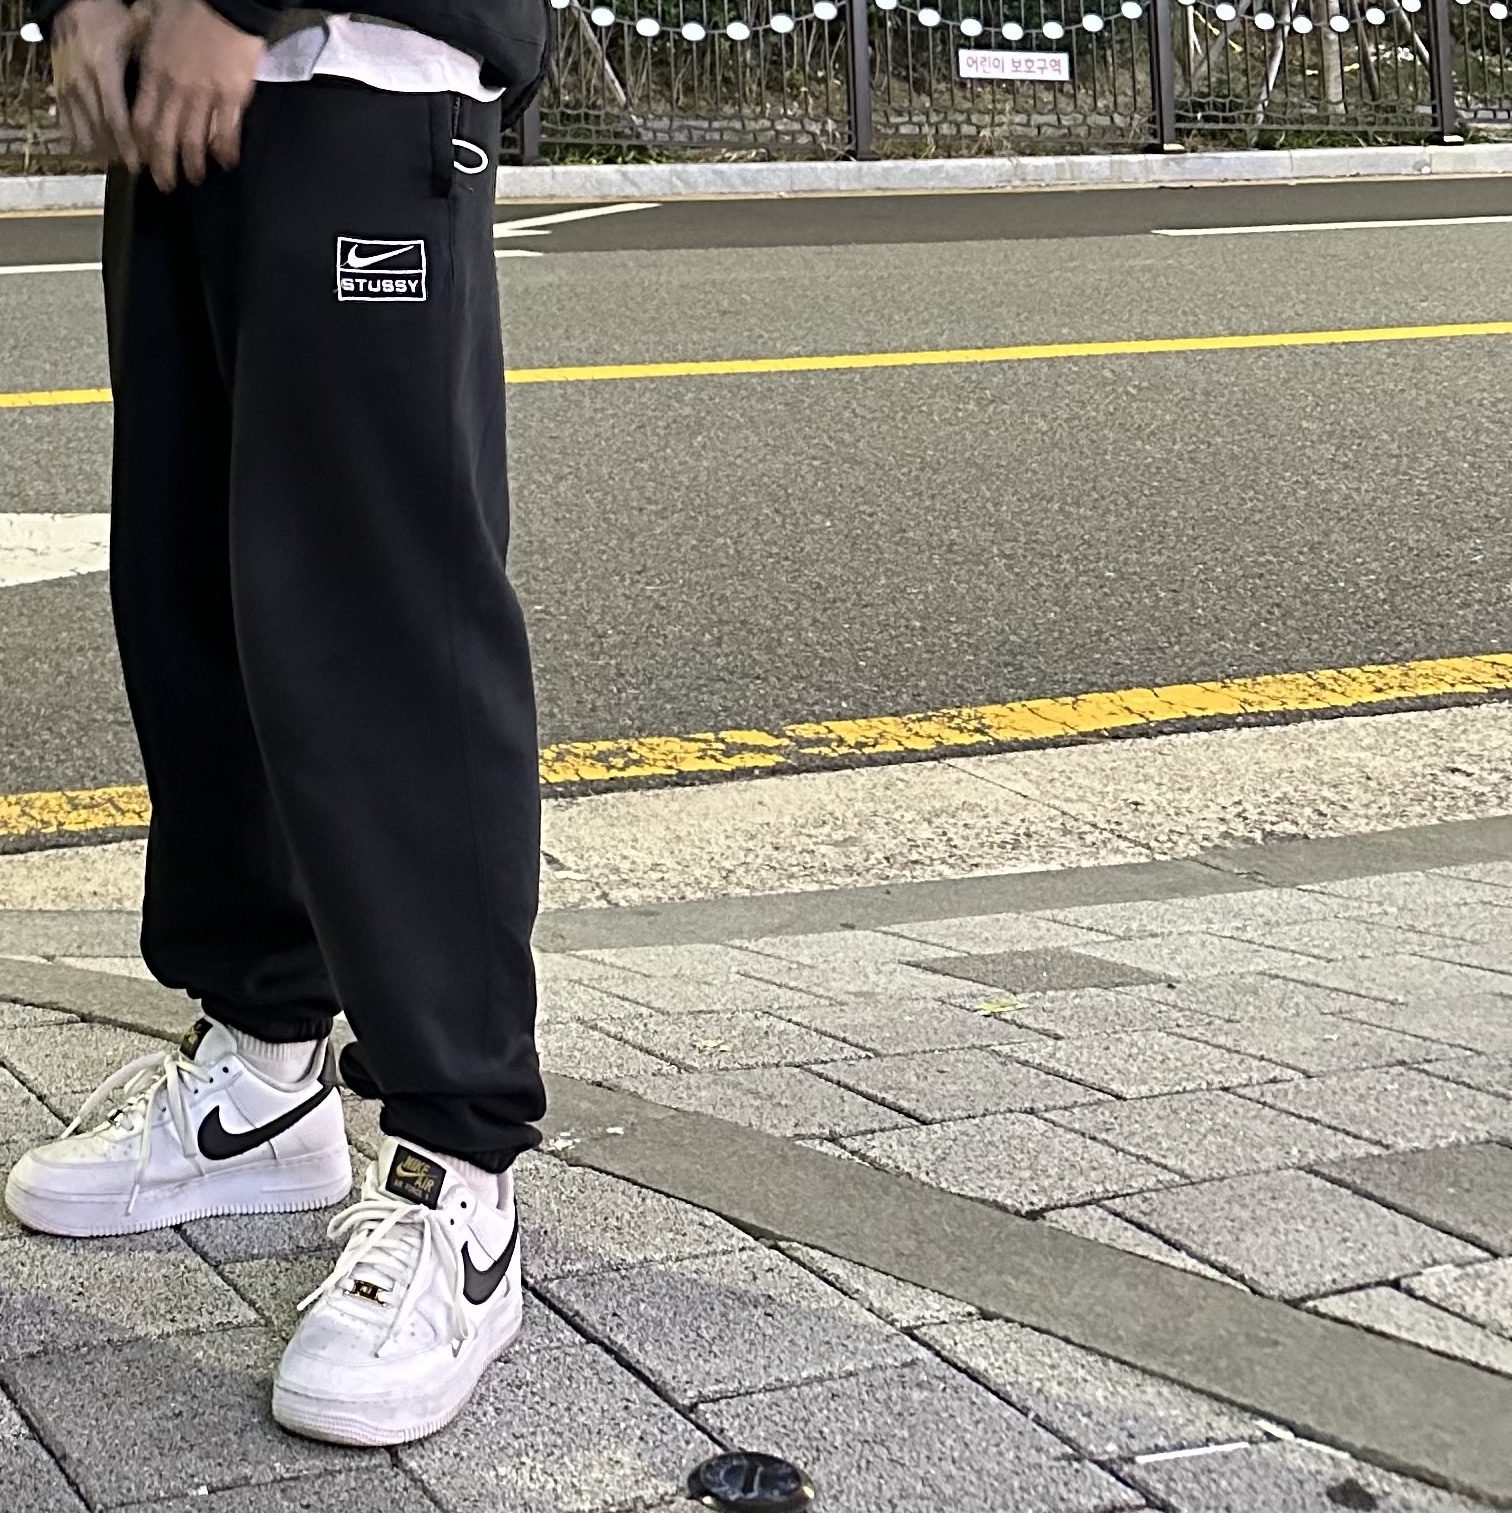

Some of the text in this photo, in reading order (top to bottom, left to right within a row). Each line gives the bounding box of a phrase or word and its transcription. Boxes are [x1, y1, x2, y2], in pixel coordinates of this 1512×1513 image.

[965, 54, 1063, 75] 어린이 보호구역
[340, 277, 419, 293] STUSSY
[402, 1155, 431, 1174] NIKE
[414, 1176, 435, 1193] AIR
